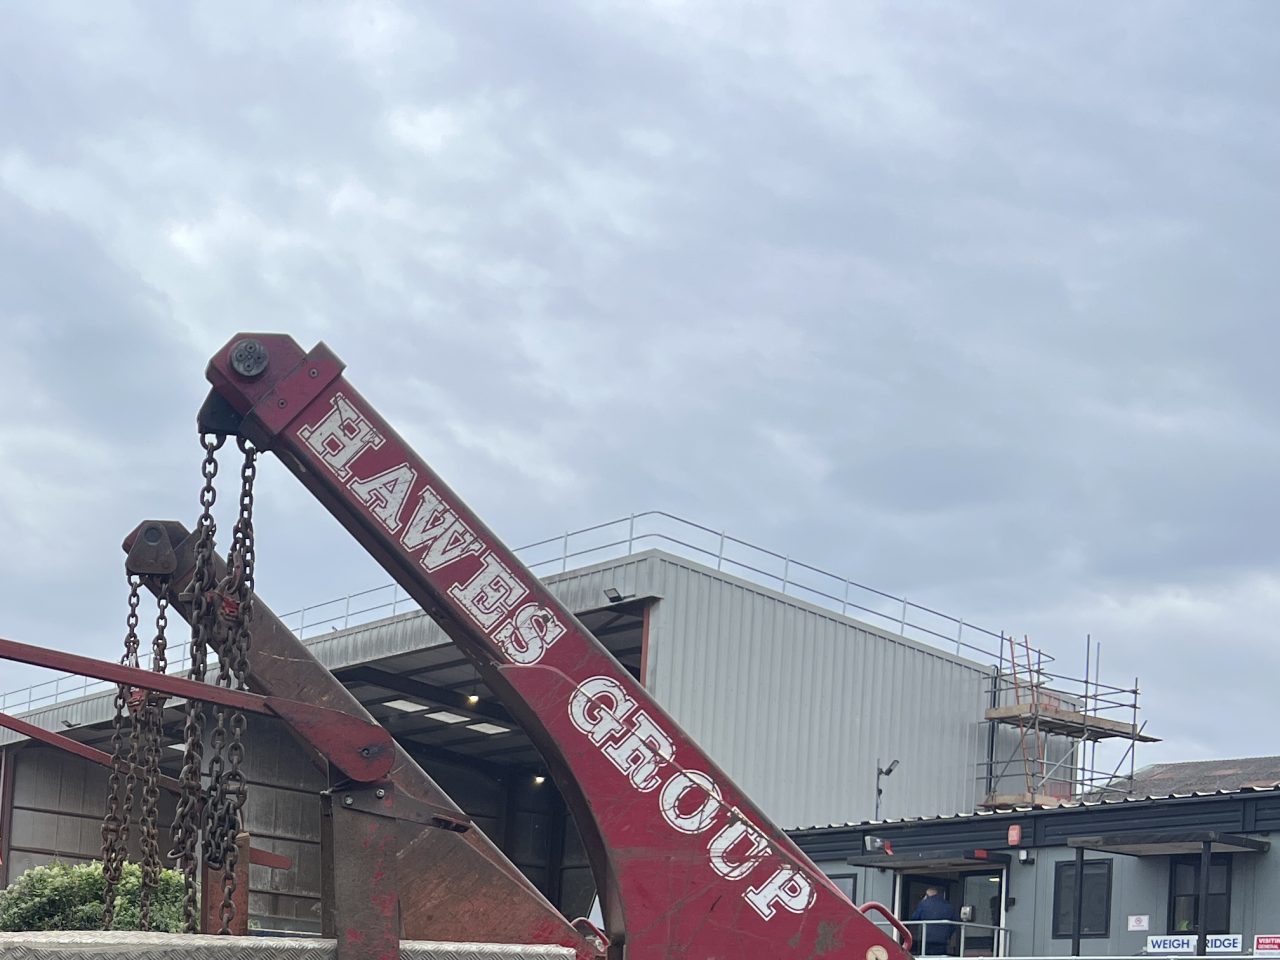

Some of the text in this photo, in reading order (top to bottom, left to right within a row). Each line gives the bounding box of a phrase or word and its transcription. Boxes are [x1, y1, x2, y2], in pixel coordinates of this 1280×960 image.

[297, 392, 567, 666] HAWES
[568, 675, 818, 921] GROUP
[1151, 938, 1239, 949] WEIGH RIDGE
